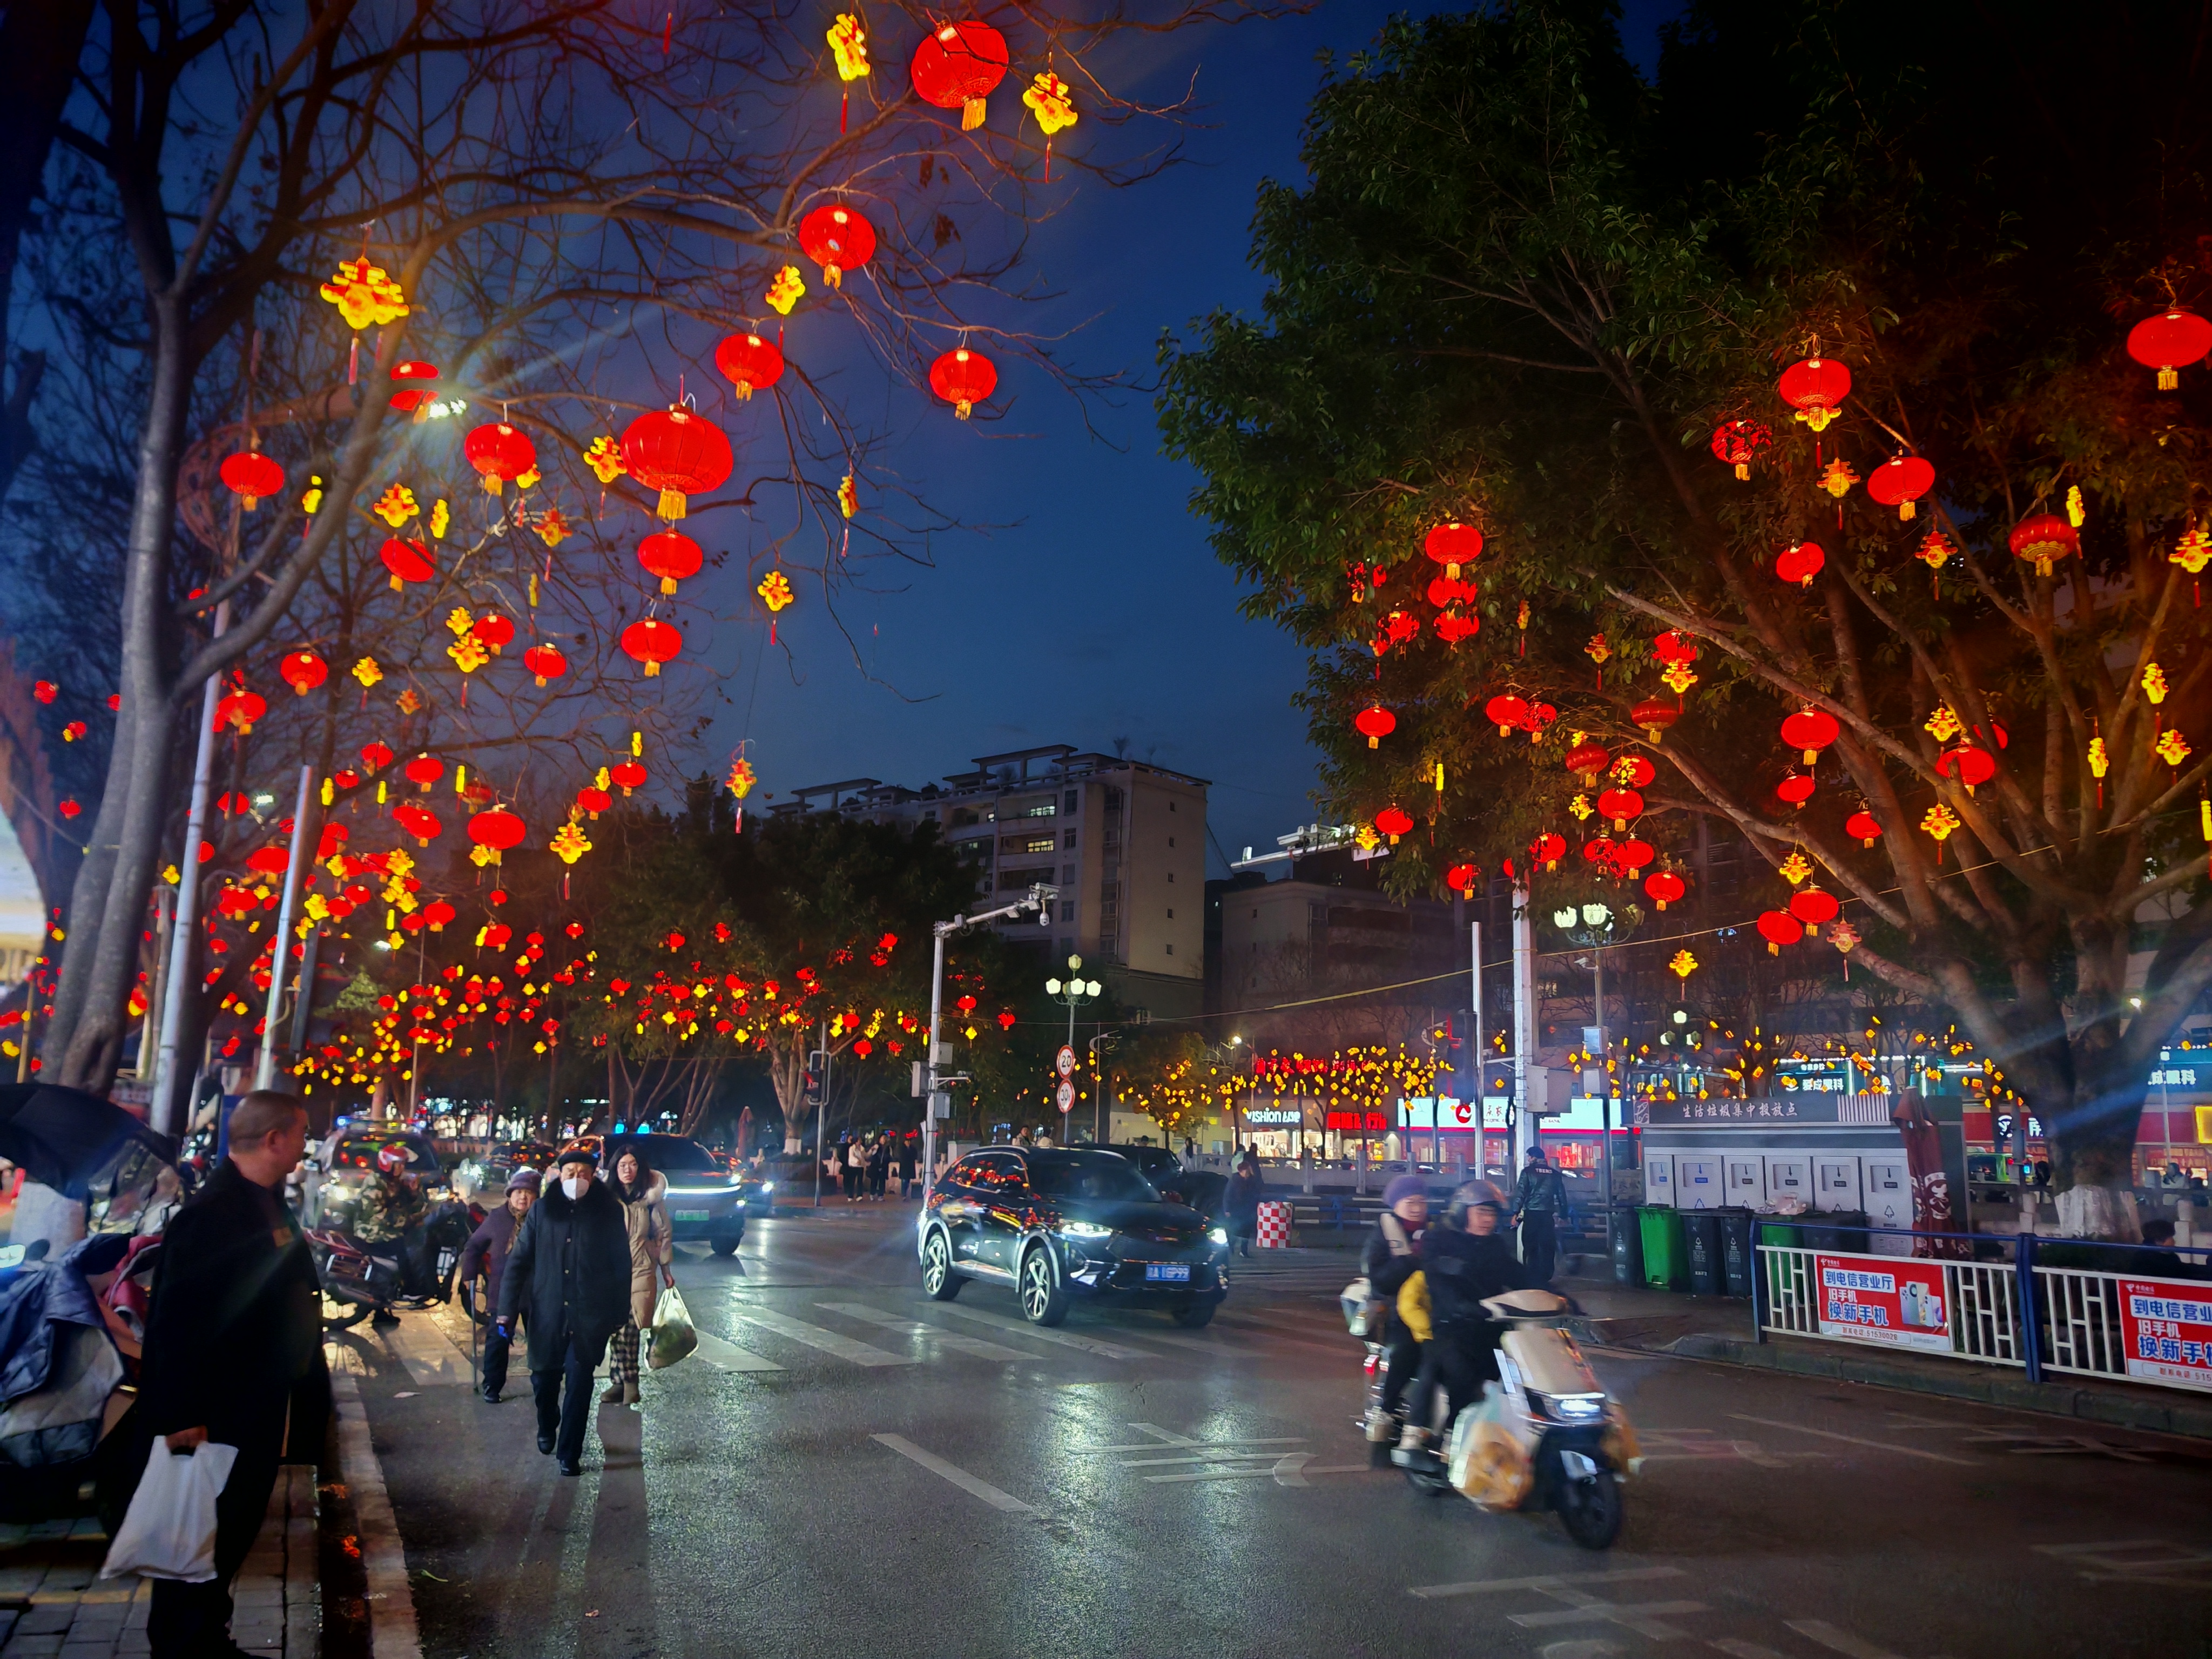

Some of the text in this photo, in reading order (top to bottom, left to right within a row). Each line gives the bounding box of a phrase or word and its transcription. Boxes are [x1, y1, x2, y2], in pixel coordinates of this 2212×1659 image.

[1061, 1055, 1071, 1068] 20
[1683, 1102, 1798, 1118] 生活垃圾集中投放点
[1826, 1271, 1893, 1290] 到电信营业厅
[1829, 1288, 1858, 1303] 旧手机
[1829, 1302, 1889, 1326] 换新手机
[2137, 1319, 2181, 1338] 旧手机
